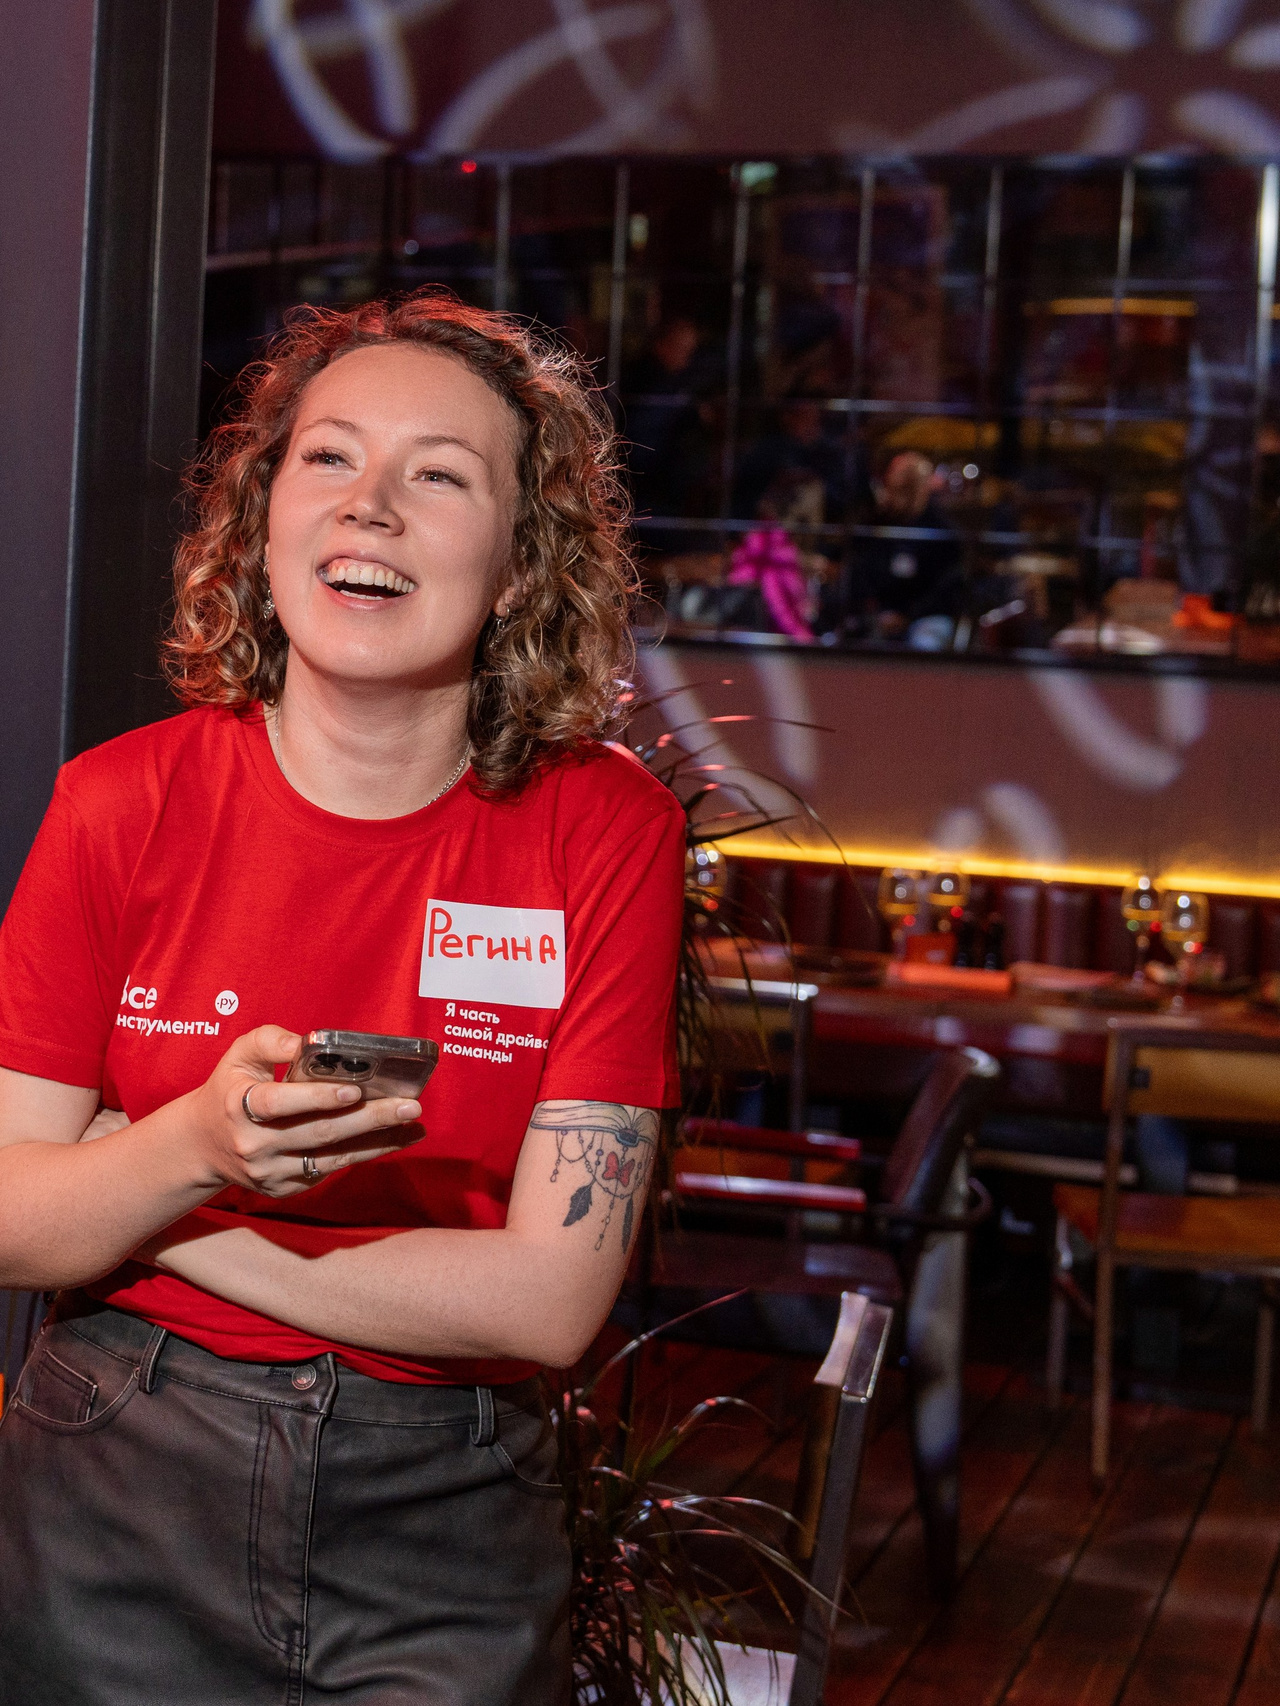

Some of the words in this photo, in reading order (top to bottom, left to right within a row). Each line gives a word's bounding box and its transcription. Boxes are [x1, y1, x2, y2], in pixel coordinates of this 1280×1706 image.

[445, 1002, 456, 1017] Я
[459, 1008, 501, 1024] часть
[116, 1013, 220, 1037] нструменты
[444, 1024, 493, 1041] самой
[443, 1042, 513, 1064] команды
